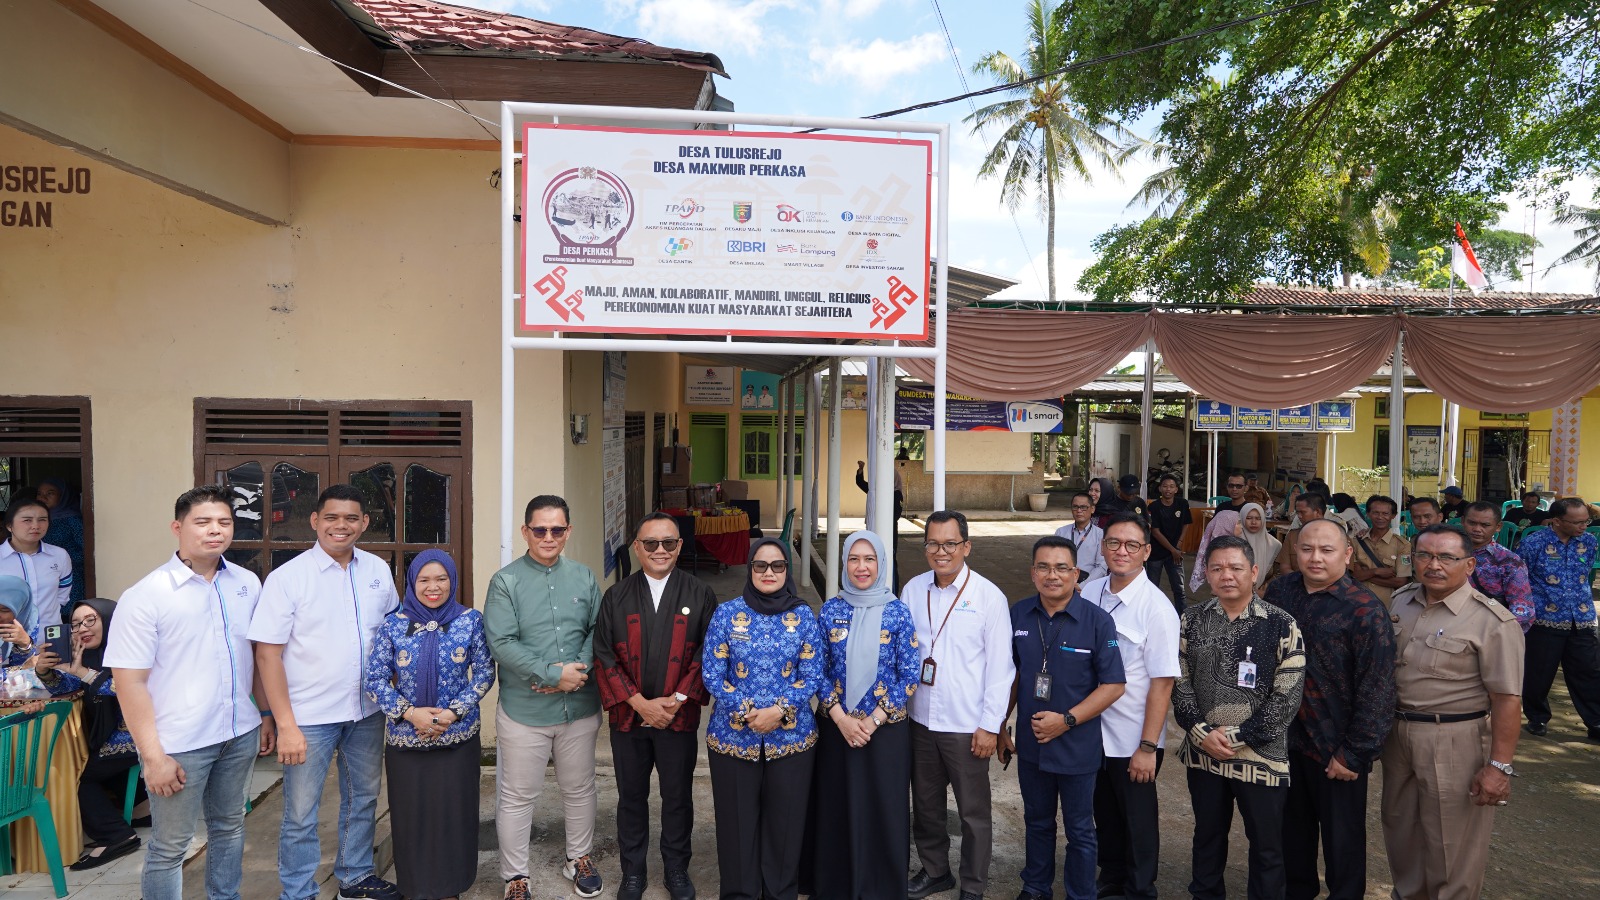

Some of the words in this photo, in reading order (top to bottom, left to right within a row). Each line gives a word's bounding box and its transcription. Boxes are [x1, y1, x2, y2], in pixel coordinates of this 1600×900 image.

[678, 146, 710, 158] DESA
[714, 146, 782, 160] TULUSREJO
[654, 161, 685, 174] DESA
[688, 162, 746, 176] MAKMUR
[750, 164, 806, 177] PERKASA
[0, 166, 90, 194] SREJO
[1, 200, 52, 228] GAN
[563, 246, 580, 255] DESA
[582, 247, 613, 256] PERKASA
[743, 242, 766, 252] BRI
[800, 249, 836, 257] Lampung
[585, 286, 619, 298] MAJU,
[622, 287, 657, 299] AMAN,
[660, 288, 731, 301] KOLABORATIF,
[735, 290, 781, 302] MANDIRI,
[785, 291, 825, 303] UNGGUL,
[829, 292, 871, 304] RELIGIUS
[604, 301, 685, 314] PEREKONOMIAN
[688, 303, 715, 314] KUAT
[718, 304, 792, 316] MASYARAKAT
[795, 306, 852, 318] SEJAHTERA
[899, 390, 926, 399] BUMDESA
